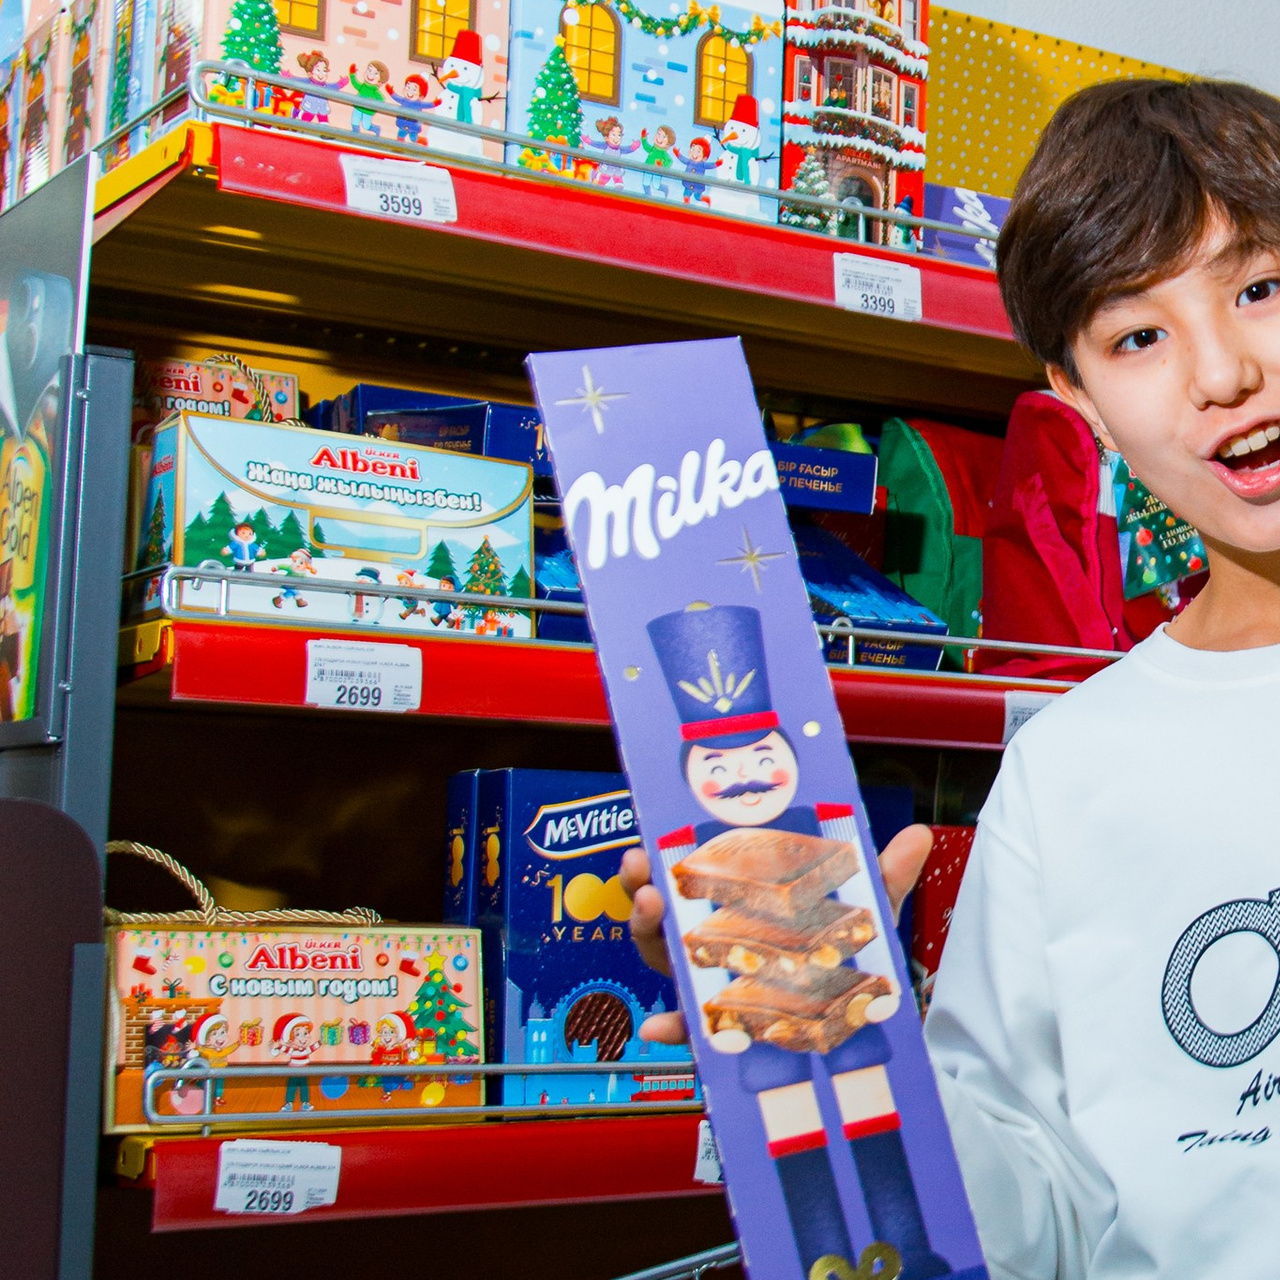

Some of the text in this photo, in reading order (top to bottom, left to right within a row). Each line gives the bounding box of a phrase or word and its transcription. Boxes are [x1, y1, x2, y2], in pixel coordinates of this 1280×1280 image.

[380, 193, 422, 216] 3599
[861, 293, 895, 315] 3399
[311, 445, 422, 482] Albeni
[364, 447, 400, 459] ÜLKER
[247, 461, 482, 511] Жаңа жылыңызбен!
[789, 477, 843, 493] ПЕЧЕНЬЕ
[565, 438, 780, 569] Milka
[336, 684, 382, 707] 2699
[304, 939, 343, 949] ÜLKER
[246, 945, 362, 972] Albeni
[209, 974, 399, 1003] С новым годом!
[244, 1189, 295, 1212] 2699
